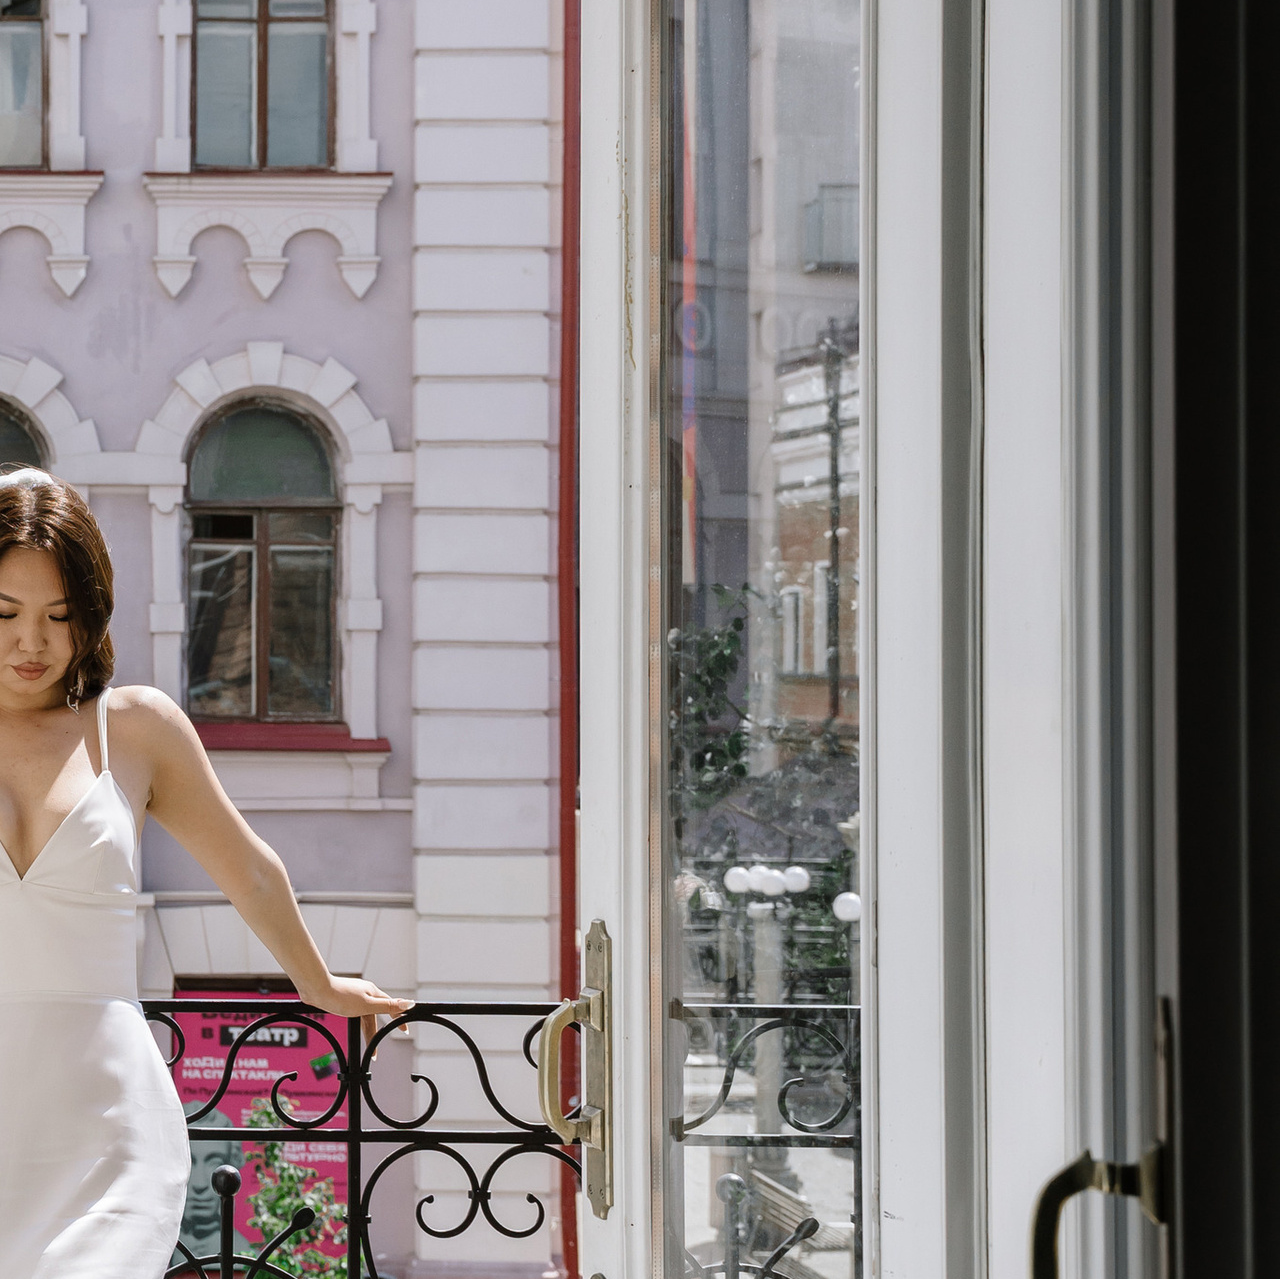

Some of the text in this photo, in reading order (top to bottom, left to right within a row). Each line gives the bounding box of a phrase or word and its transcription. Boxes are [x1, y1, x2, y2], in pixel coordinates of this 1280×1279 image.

[238, 1057, 269, 1069] НАМ
[182, 1068, 284, 1082] НА СПКТАКЛ
